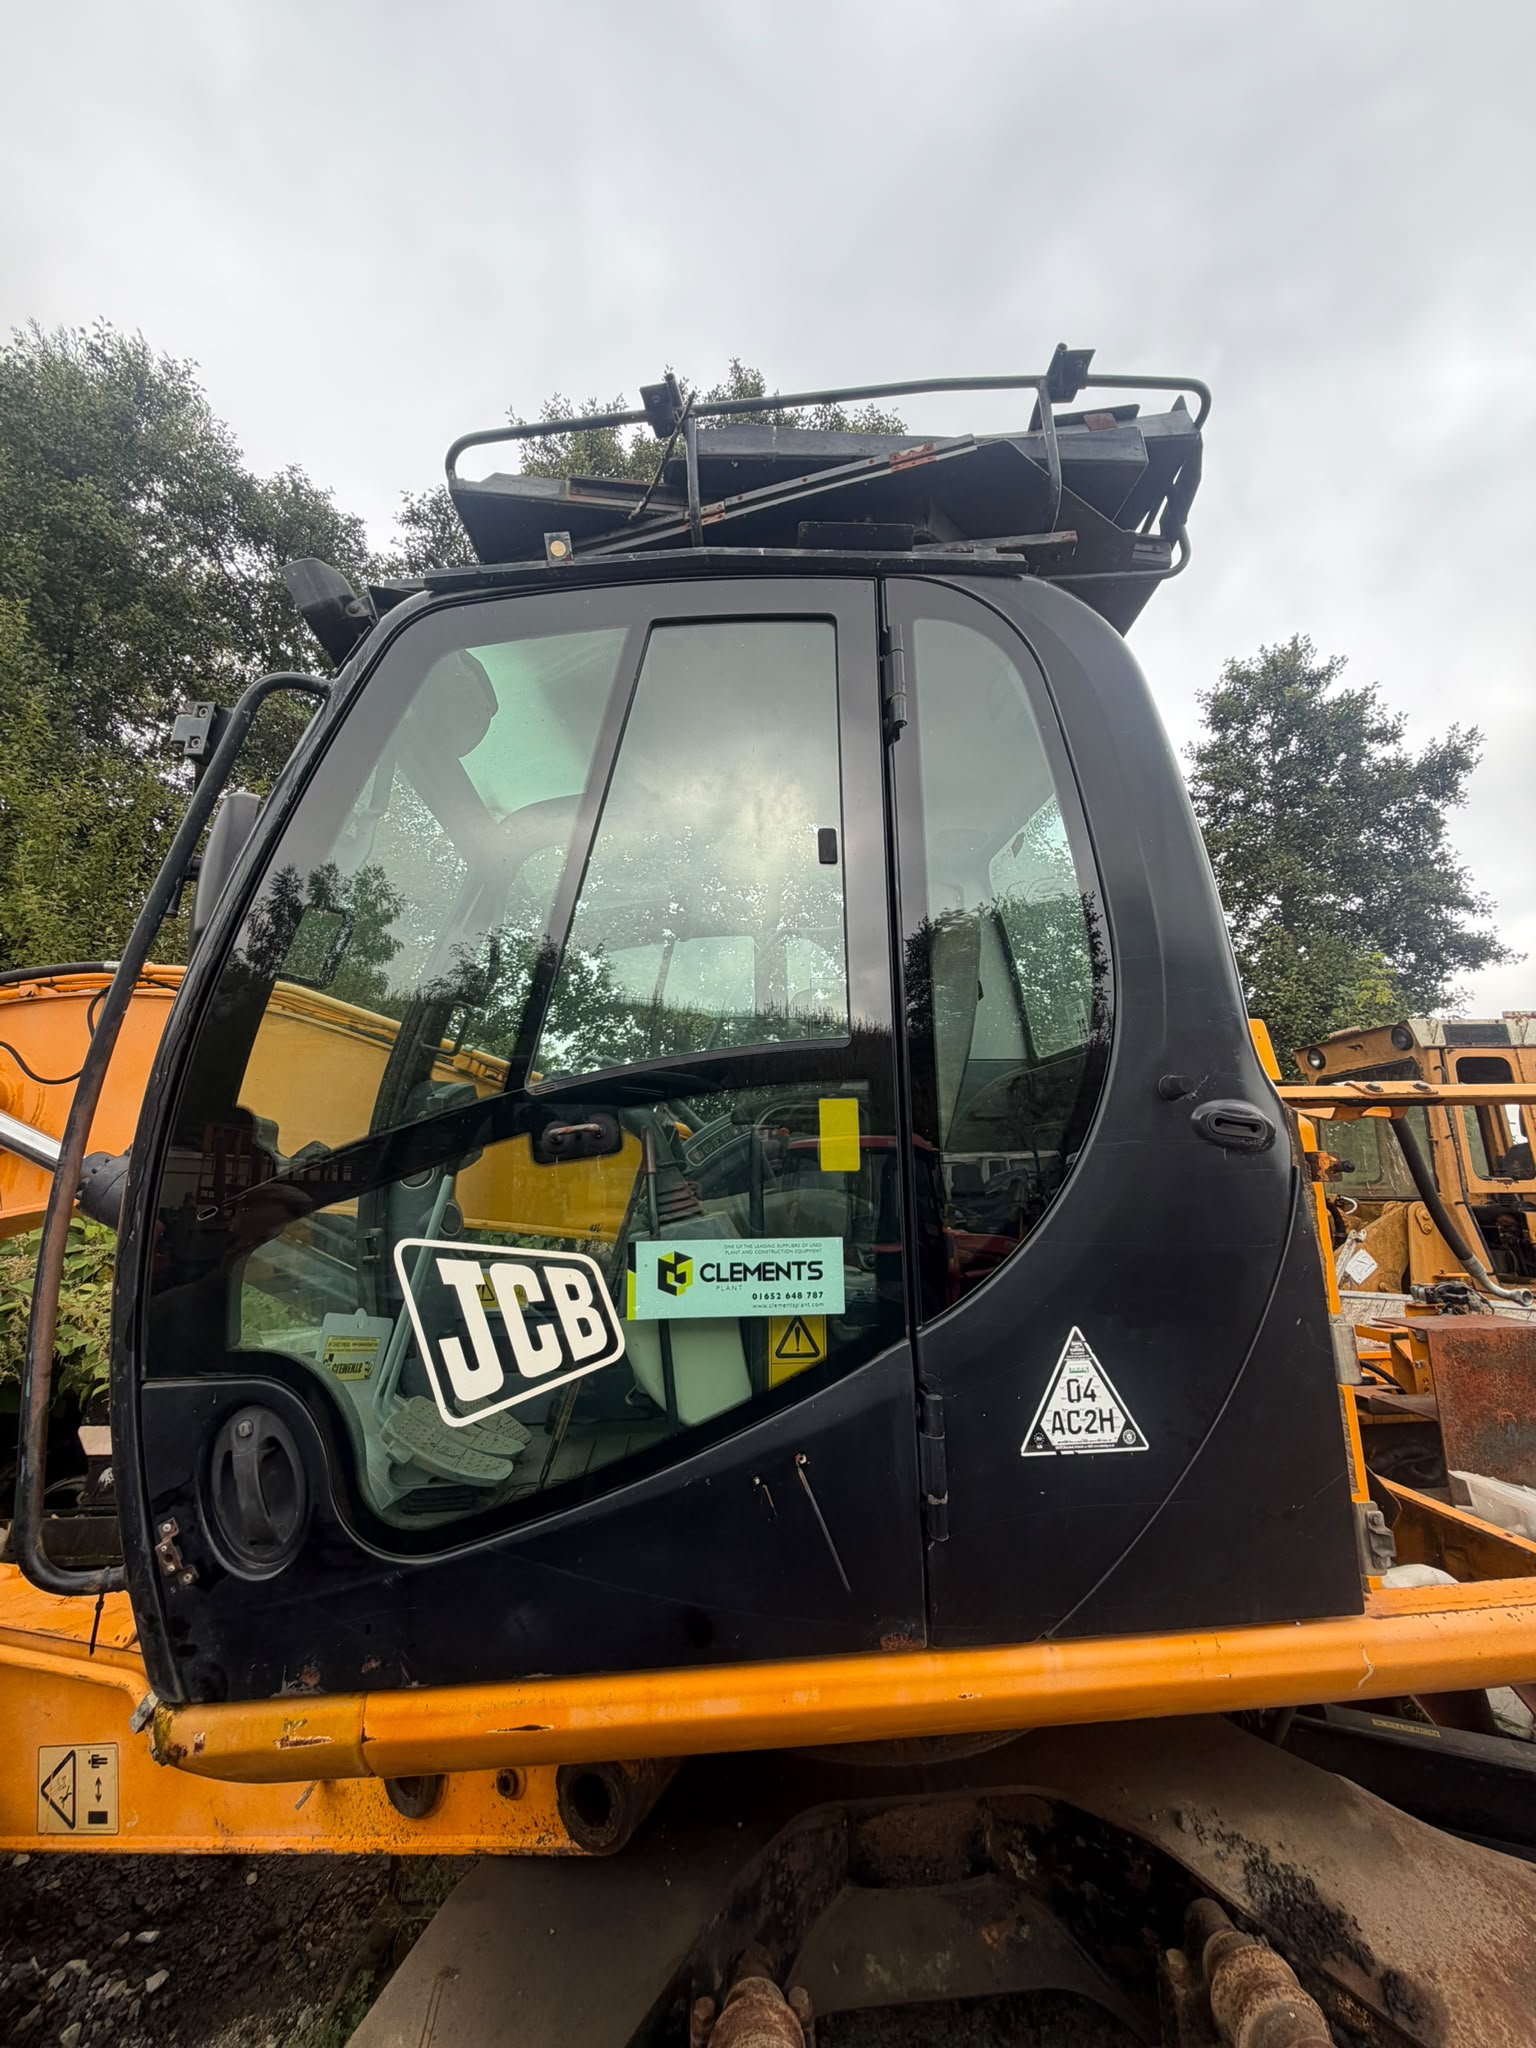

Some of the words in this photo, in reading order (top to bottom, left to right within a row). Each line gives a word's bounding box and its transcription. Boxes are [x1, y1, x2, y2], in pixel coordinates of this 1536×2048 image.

[699, 1261, 824, 1283] CLEMENTS
[752, 1292, 781, 1300] 01652
[785, 1292, 803, 1300] 648
[806, 1291, 824, 1299] 787
[436, 1257, 608, 1401] JCB
[1051, 1408, 1115, 1436] AC2H
